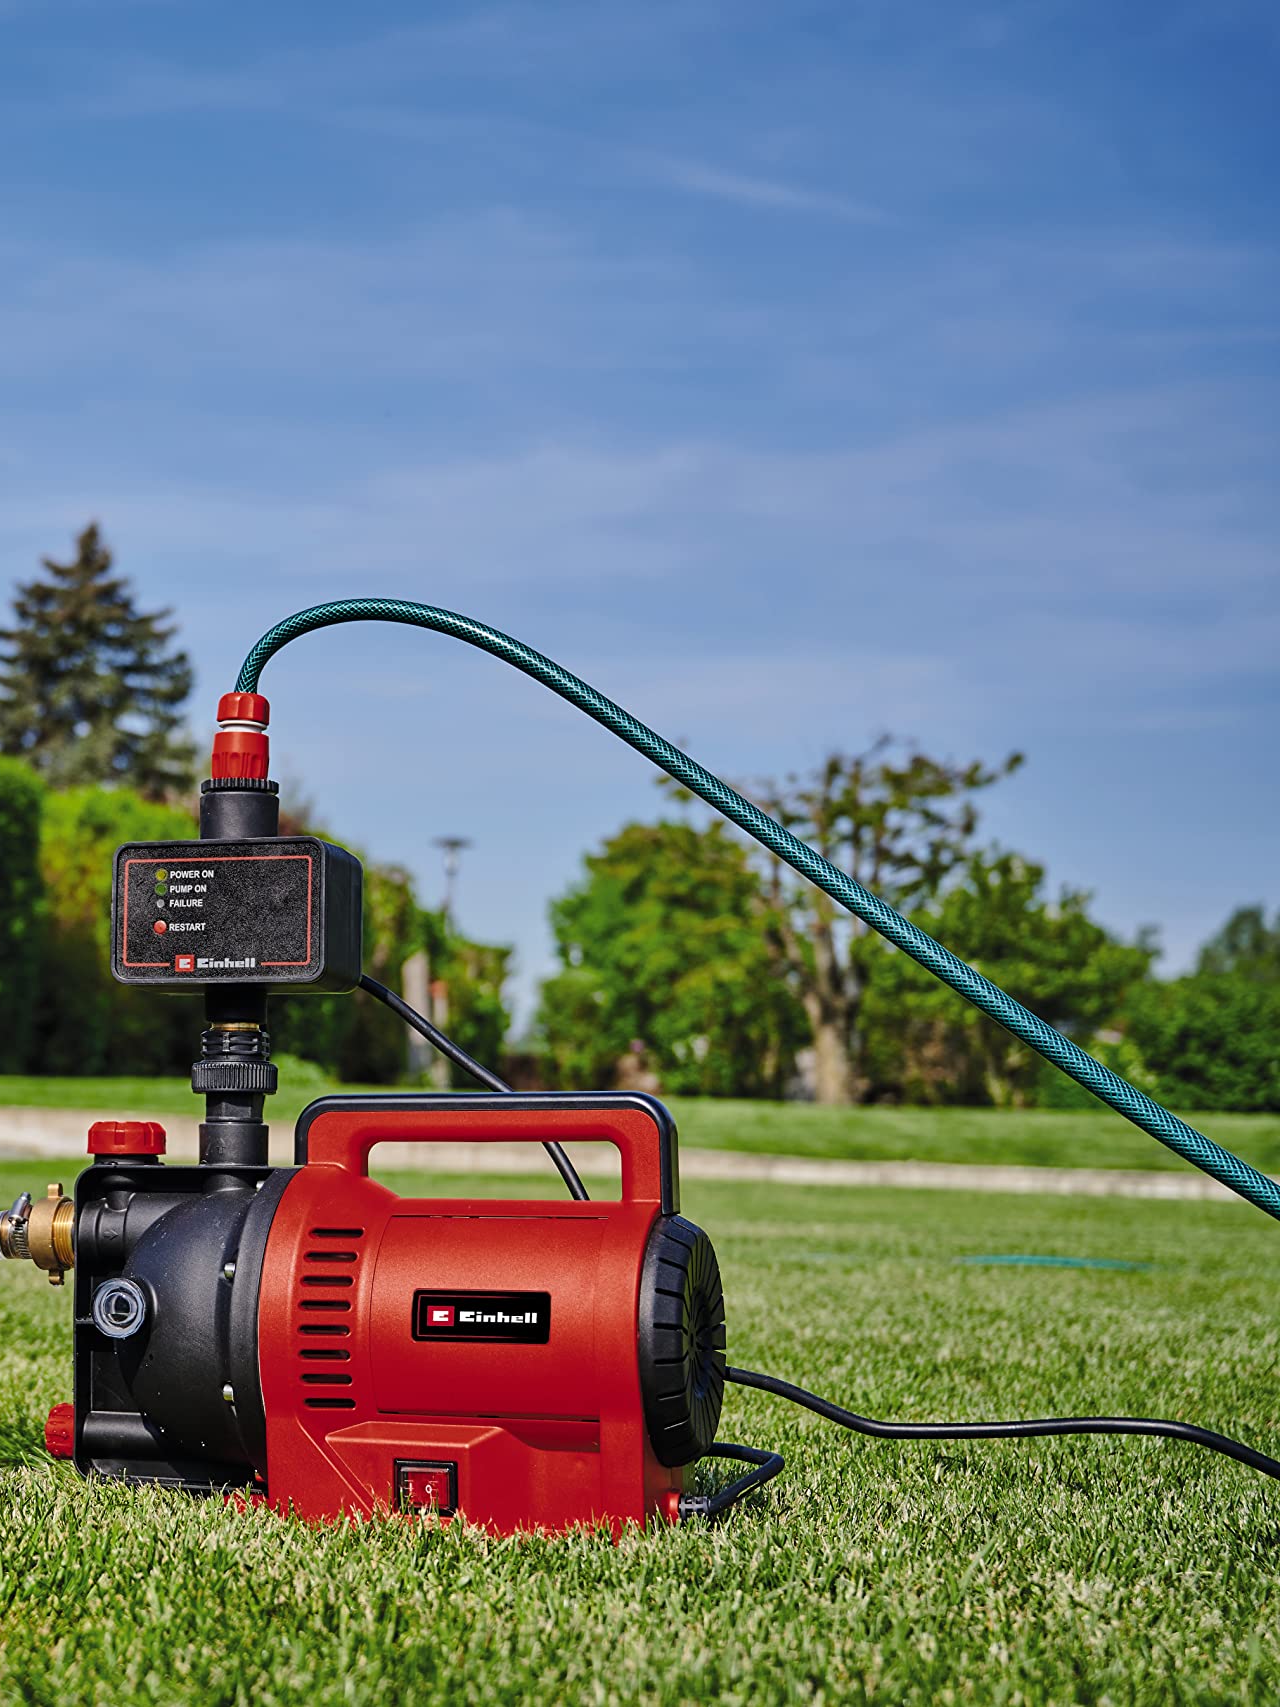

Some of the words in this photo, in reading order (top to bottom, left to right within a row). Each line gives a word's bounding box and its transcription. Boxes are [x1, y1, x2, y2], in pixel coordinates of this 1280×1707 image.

[170, 870, 200, 879] POWER
[201, 870, 214, 878] ON
[170, 885, 193, 893] PUMP
[194, 884, 207, 893] ON
[169, 899, 203, 908] FAILURE
[169, 922, 206, 931] RESTART
[197, 958, 255, 968] Einhell
[459, 1311, 538, 1324] Einhell
